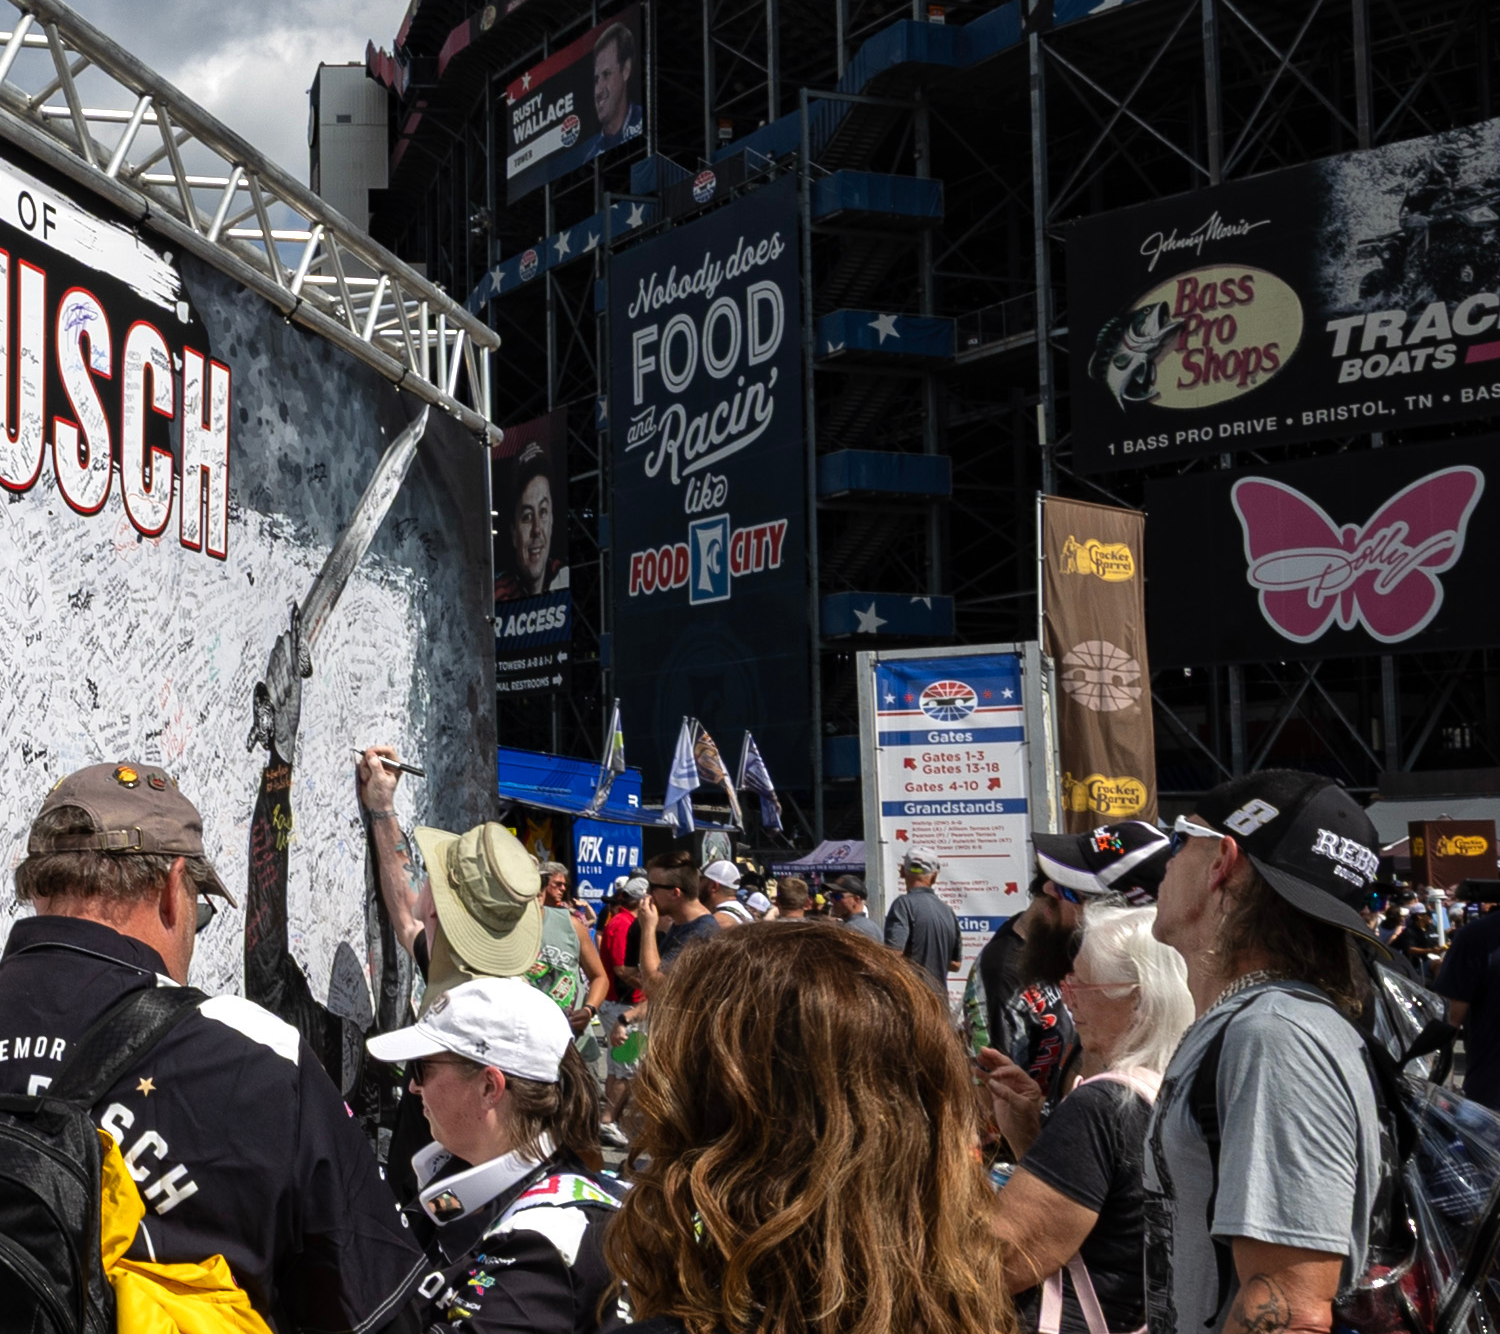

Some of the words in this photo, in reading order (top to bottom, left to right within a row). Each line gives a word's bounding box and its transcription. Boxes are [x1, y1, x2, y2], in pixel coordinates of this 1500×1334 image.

[513, 93, 542, 125] RUSTY
[513, 92, 574, 144] WALLACE
[16, 185, 58, 239] OF
[1141, 230, 1206, 271] Johnny
[1198, 211, 1271, 254] Morris
[628, 259, 725, 320] Nobody
[726, 230, 785, 278] does
[1173, 273, 1255, 319] Bass
[632, 280, 785, 406] FOOD
[1176, 313, 1238, 355] Pro
[1176, 342, 1281, 392] Shops
[1338, 344, 1457, 384] BOATS
[645, 369, 778, 484] Racin'
[1108, 444, 1117, 457] 1
[1123, 434, 1169, 455] BASS
[1174, 426, 1213, 445] PRO
[1218, 417, 1279, 438] DRIVE
[1302, 399, 1396, 427] BRISTOL,
[1405, 394, 1434, 412] TN
[684, 473, 728, 515] like
[629, 538, 690, 596] FOOD
[730, 519, 788, 577] CITY
[1089, 543, 1129, 563] Cracker
[1095, 559, 1131, 577] Barrel
[504, 604, 567, 637] ACCESS
[499, 658, 526, 671] TOWERS
[511, 677, 550, 691] RESTROOMS
[927, 731, 973, 744] Gates
[922, 752, 961, 763] Gates
[965, 751, 985, 762] 1-3
[922, 763, 962, 775] Gates
[966, 762, 1000, 773] 13-18
[904, 781, 944, 793] Gates
[949, 780, 979, 792] 4-10
[1088, 779, 1139, 796] Cracker
[904, 801, 1004, 815] Grandstands
[1096, 794, 1140, 812] Barrel
[577, 835, 602, 864] RFK
[605, 844, 613, 866] 6
[617, 843, 627, 866] 17
[629, 842, 639, 866] 60
[577, 866, 602, 874] RACING
[959, 917, 990, 932] king
[100, 1102, 199, 1215] SCH
